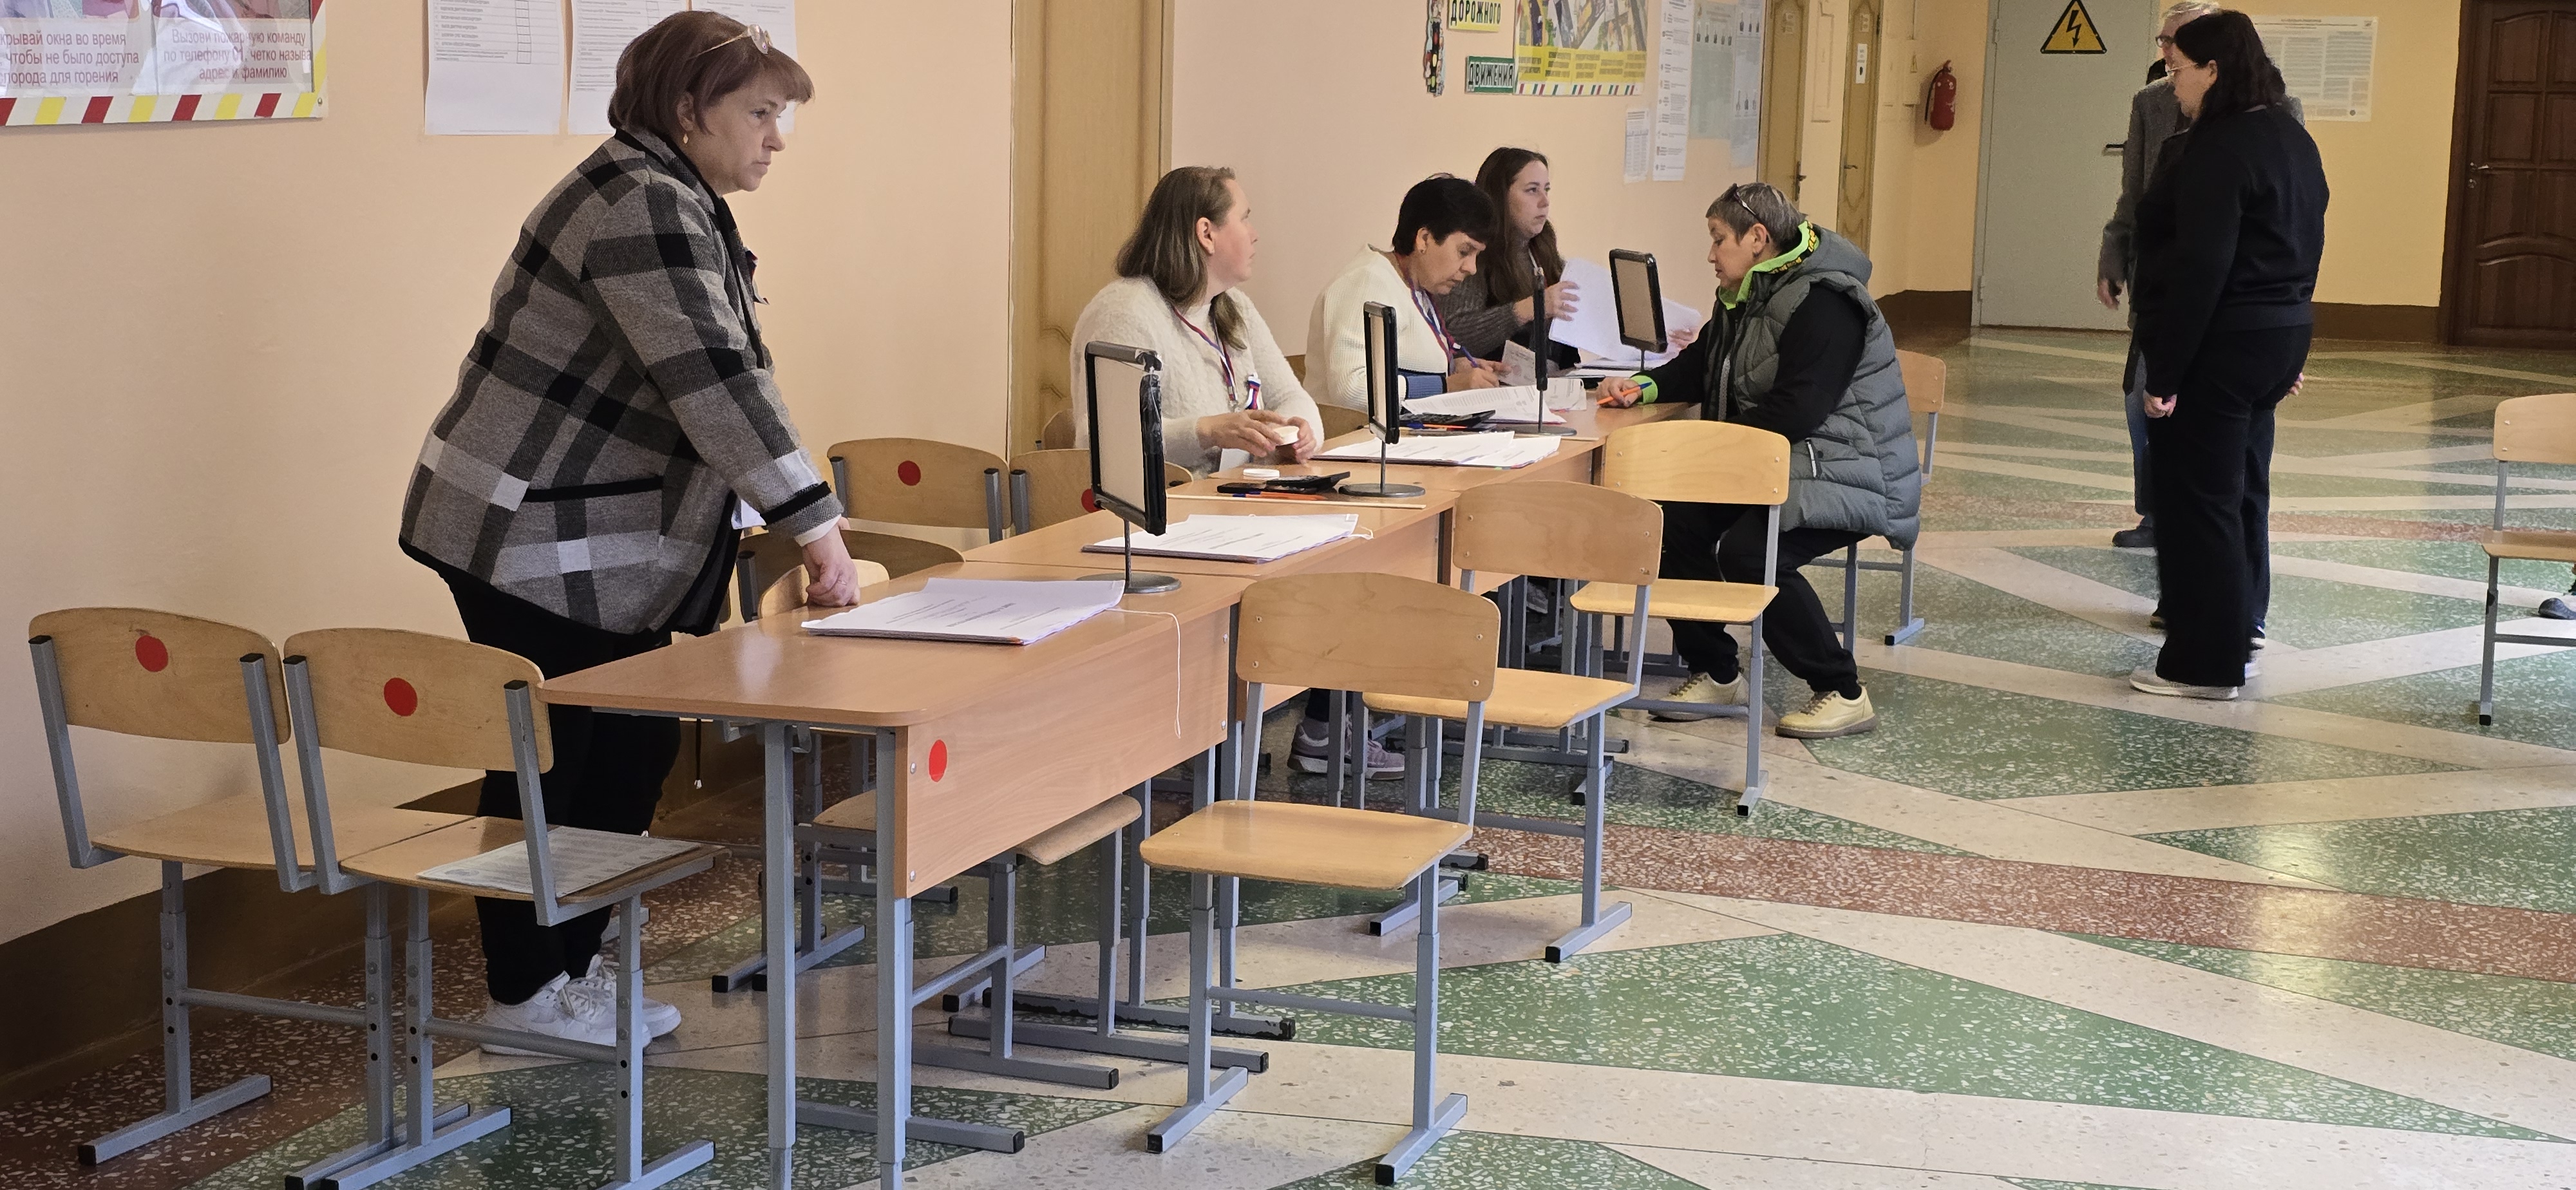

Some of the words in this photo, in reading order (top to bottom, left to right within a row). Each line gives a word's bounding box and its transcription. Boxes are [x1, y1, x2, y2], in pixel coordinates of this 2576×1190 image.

[1450, 0, 1501, 26] ДОРОЖНОГО
[46, 33, 73, 46] окна
[76, 33, 89, 46] во
[93, 33, 126, 48] время
[172, 29, 211, 44] Вызови
[267, 32, 306, 47] команду
[5, 49, 43, 64] чтобы
[46, 52, 60, 64] не
[62, 49, 93, 64] было
[96, 52, 139, 68] доступа
[164, 50, 177, 62] по
[180, 46, 230, 64] телефону
[250, 50, 276, 61] четко
[50, 71, 71, 86] для
[74, 71, 118, 85] горения
[199, 68, 231, 82] адрес
[232, 68, 240, 79] и
[242, 65, 287, 82] фамилию
[1468, 62, 1513, 90] ДВИЖЕНИЯ
